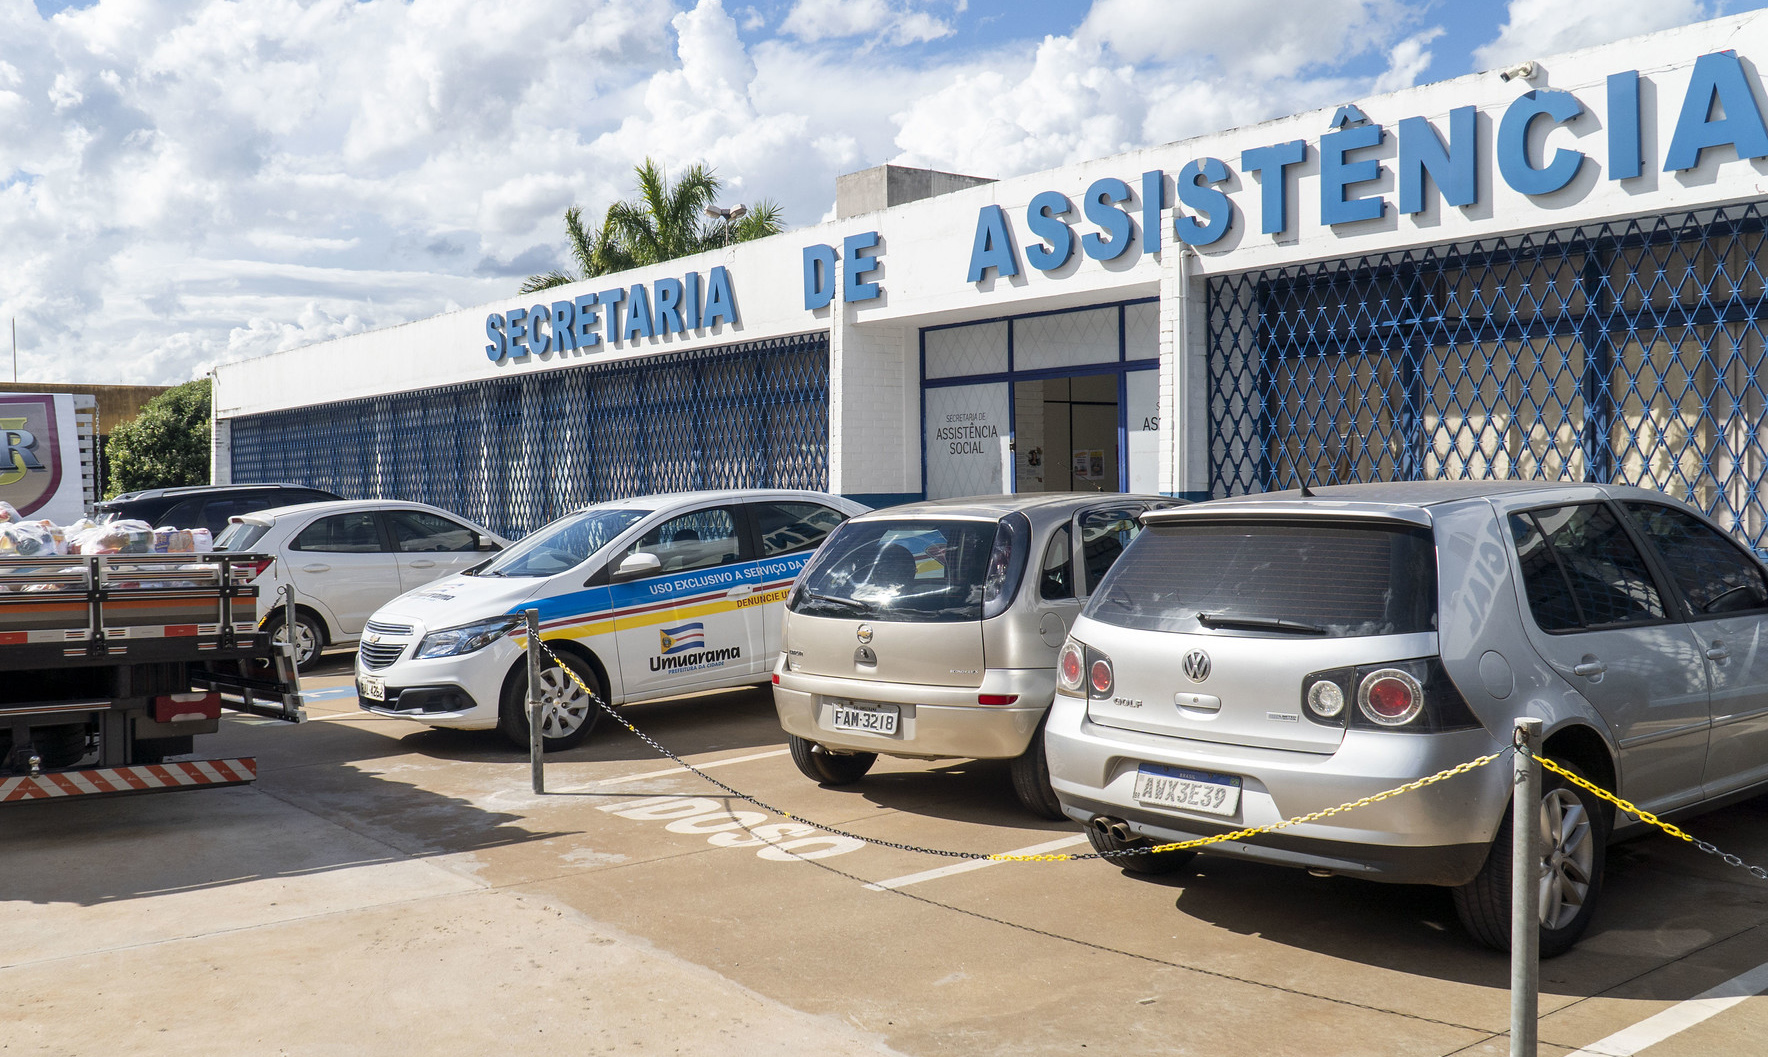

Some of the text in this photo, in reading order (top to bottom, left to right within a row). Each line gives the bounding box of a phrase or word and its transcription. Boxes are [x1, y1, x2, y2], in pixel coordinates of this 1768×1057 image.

[485, 48, 1768, 361] SECRETARIA DE ASSISTÊNCIA
[946, 412, 986, 423] SECRETARIA DE
[1142, 416, 1161, 431] AS
[936, 422, 998, 441] ASSISTÊNCIA
[949, 440, 984, 455] SOCIAL
[649, 581, 673, 595] USO
[674, 571, 734, 591] EXCLUSIVO
[735, 569, 744, 580] A
[745, 562, 787, 579] SERVIÇO
[787, 560, 803, 570] DA
[736, 592, 781, 609] DENUNCIE
[649, 646, 741, 672] Umuarama
[668, 666, 698, 675] PREFEITURA
[706, 660, 725, 669] CIDADE
[1113, 697, 1143, 709] GOLF
[595, 795, 867, 862] IDOSO
